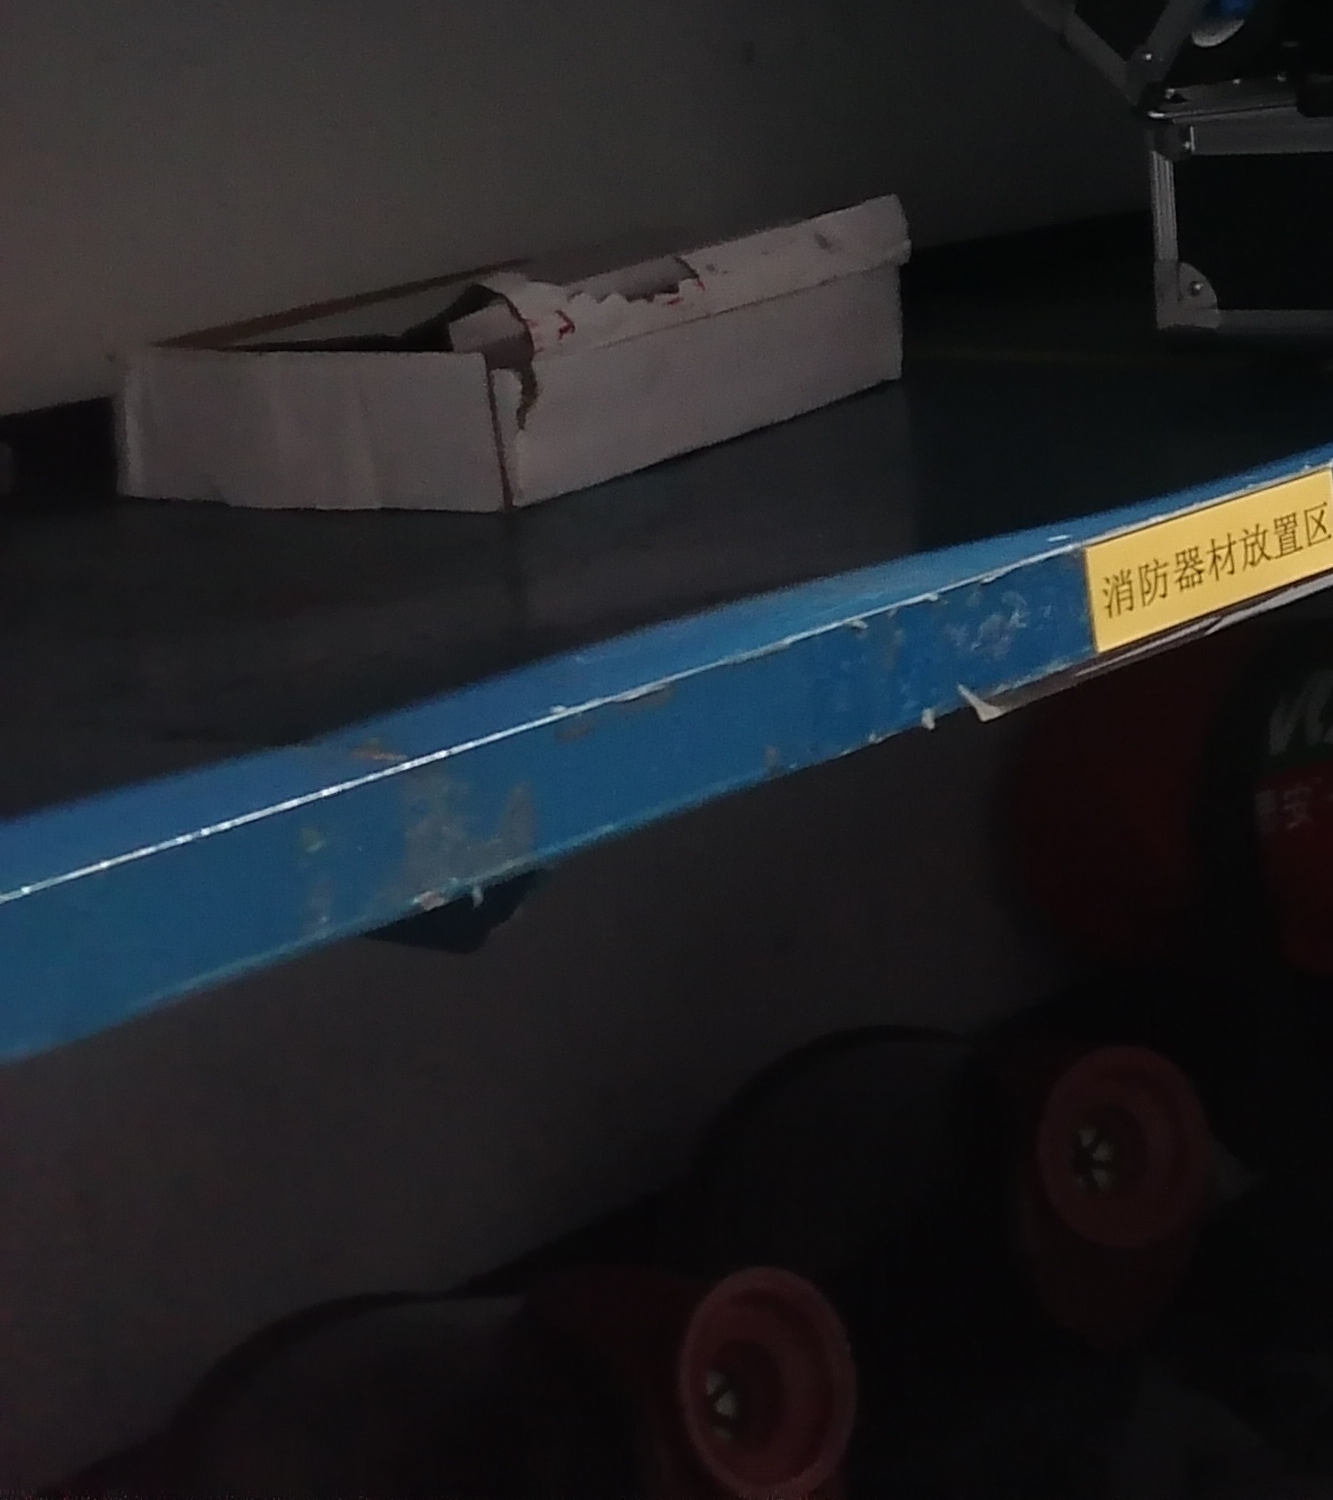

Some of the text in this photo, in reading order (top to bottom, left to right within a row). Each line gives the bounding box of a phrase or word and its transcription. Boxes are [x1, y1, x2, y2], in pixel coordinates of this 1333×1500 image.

[1101, 501, 1332, 619] 消防器材放置区
